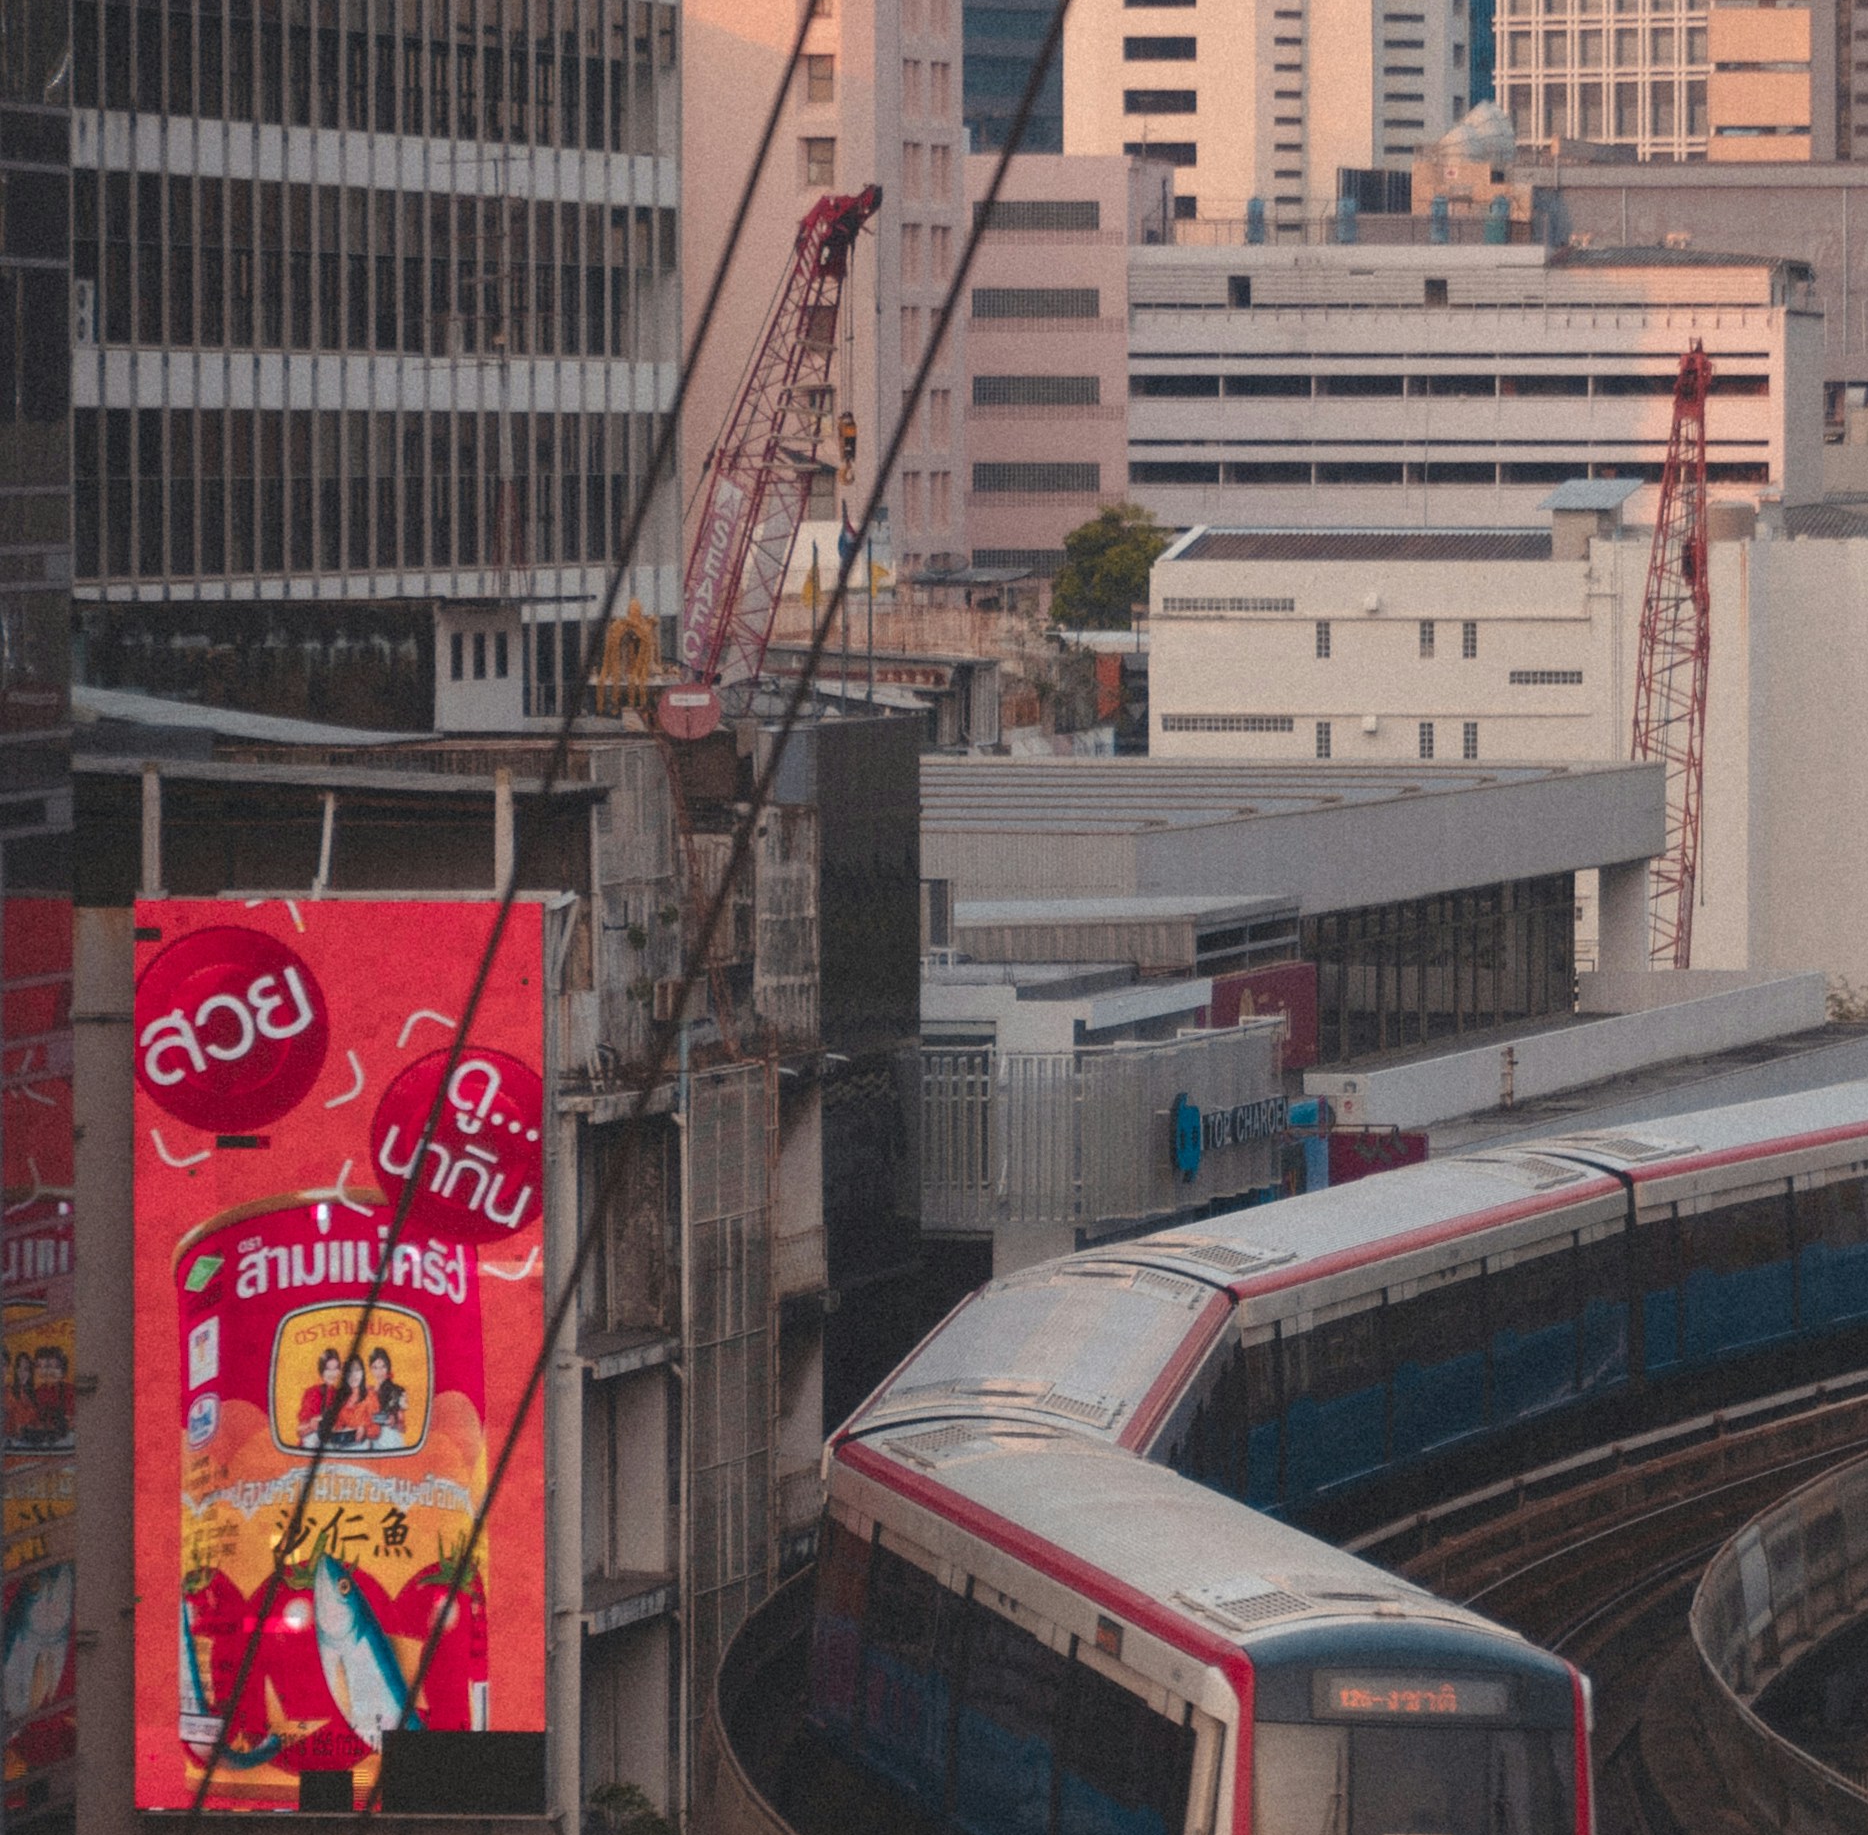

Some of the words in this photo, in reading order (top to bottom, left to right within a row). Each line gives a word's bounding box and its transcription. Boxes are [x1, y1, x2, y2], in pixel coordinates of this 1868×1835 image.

[683, 520, 729, 665] SEAFC
[138, 964, 317, 1088] สวย
[447, 1058, 540, 1143] ดู...
[235, 1227, 468, 1305] สามแม่ครัว
